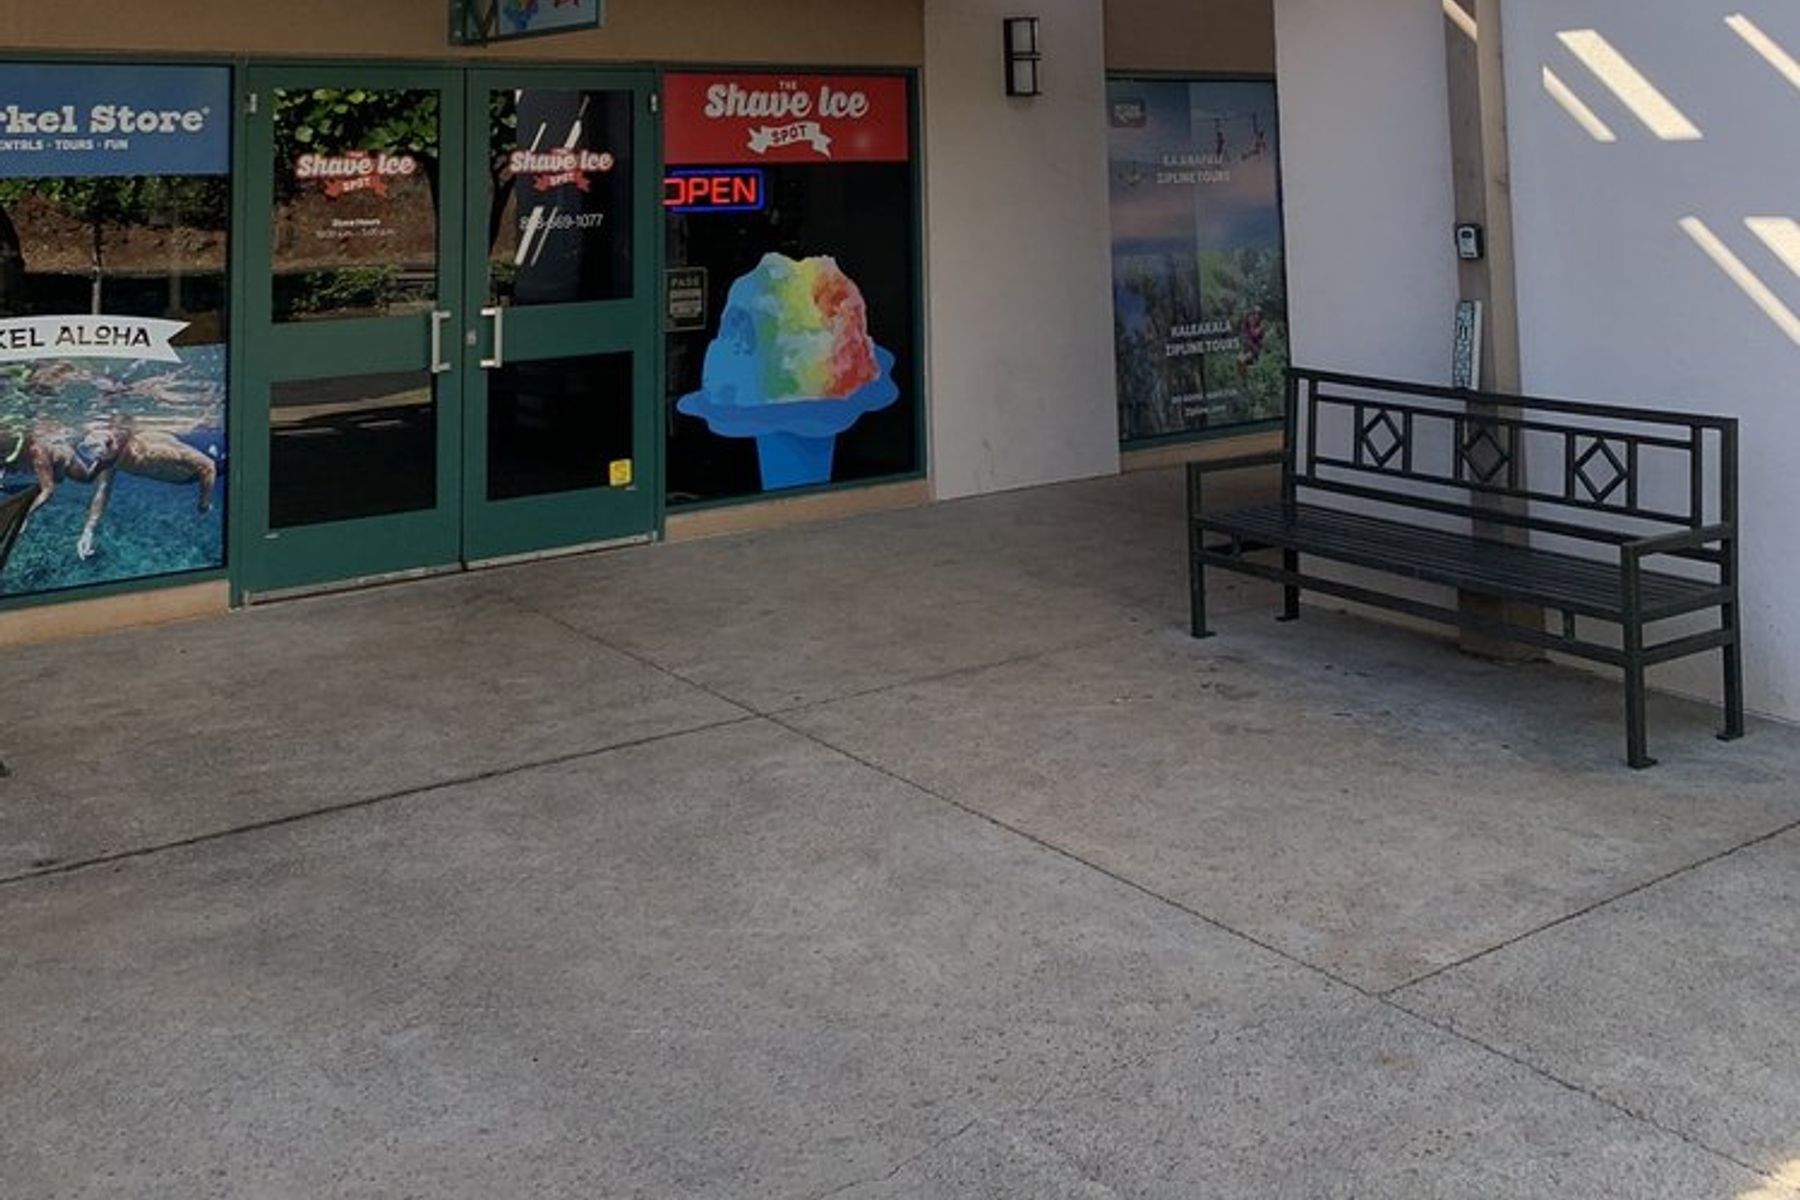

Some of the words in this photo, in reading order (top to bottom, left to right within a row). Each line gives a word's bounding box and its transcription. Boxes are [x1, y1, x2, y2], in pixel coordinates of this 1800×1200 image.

[779, 81, 798, 90] THE
[704, 82, 813, 118] Shave
[818, 85, 870, 118] Ice
[770, 124, 808, 143] SPOT
[54, 139, 94, 151] TOURS
[103, 139, 129, 151] FUN
[296, 154, 372, 178] Shave
[377, 154, 416, 175] Ice
[510, 150, 577, 172] Shave
[580, 149, 614, 172] Ice
[662, 176, 758, 206] OPEN
[55, 325, 151, 347] ALOHA
